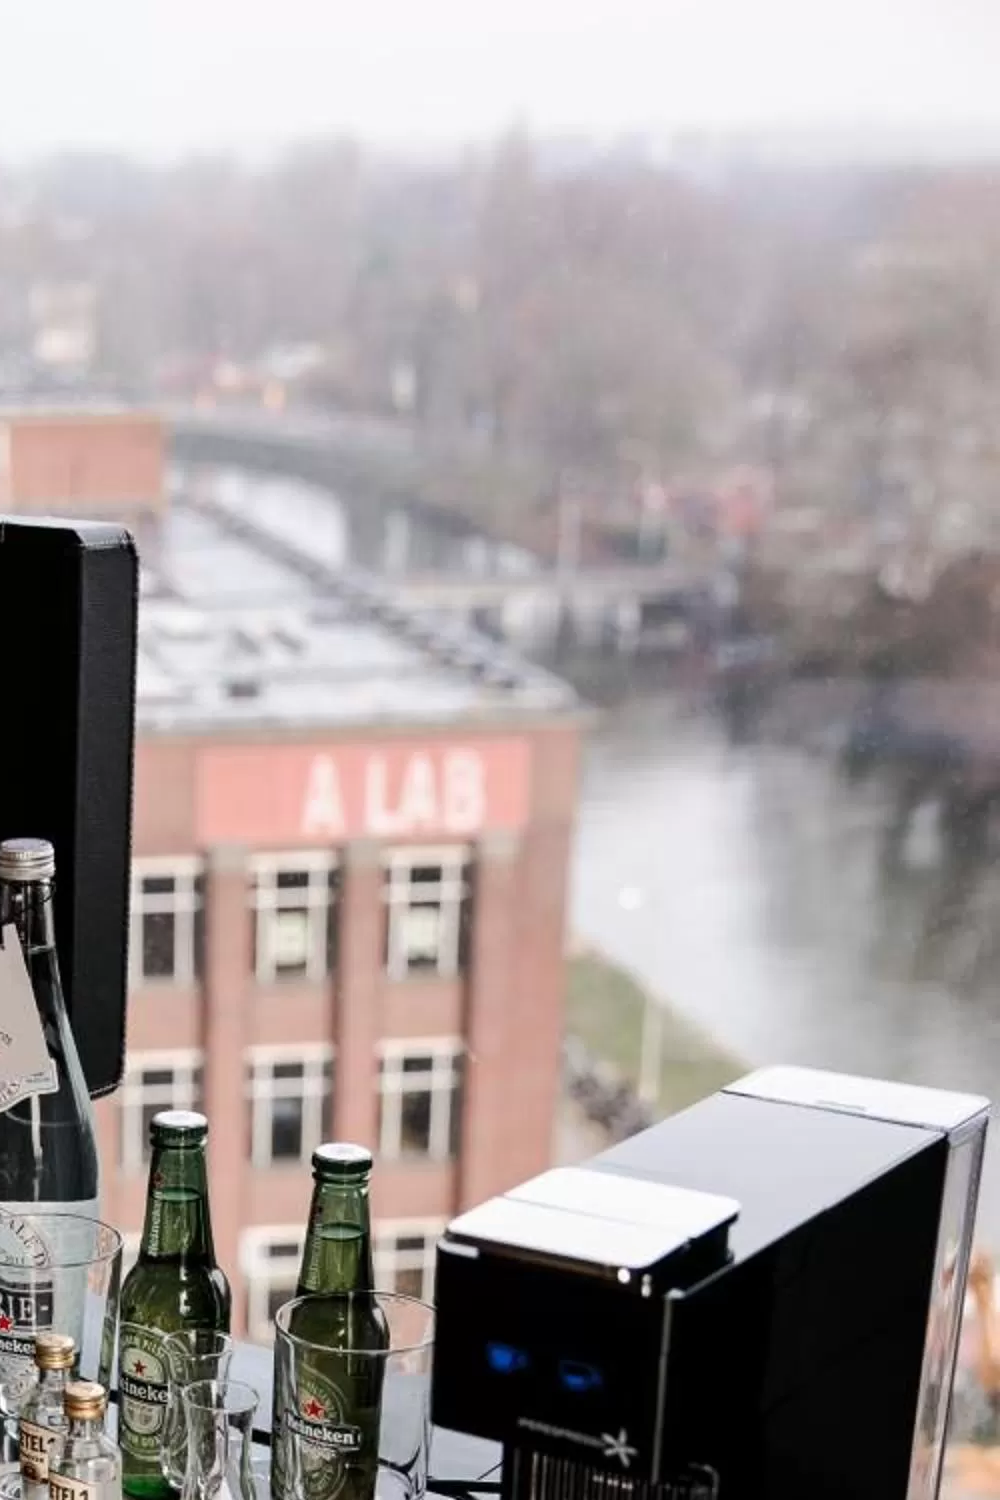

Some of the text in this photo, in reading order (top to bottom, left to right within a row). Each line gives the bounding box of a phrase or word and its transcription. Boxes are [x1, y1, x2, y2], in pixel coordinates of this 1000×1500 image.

[300, 748, 485, 834] A LAB
[119, 1378, 169, 1402] eineke
